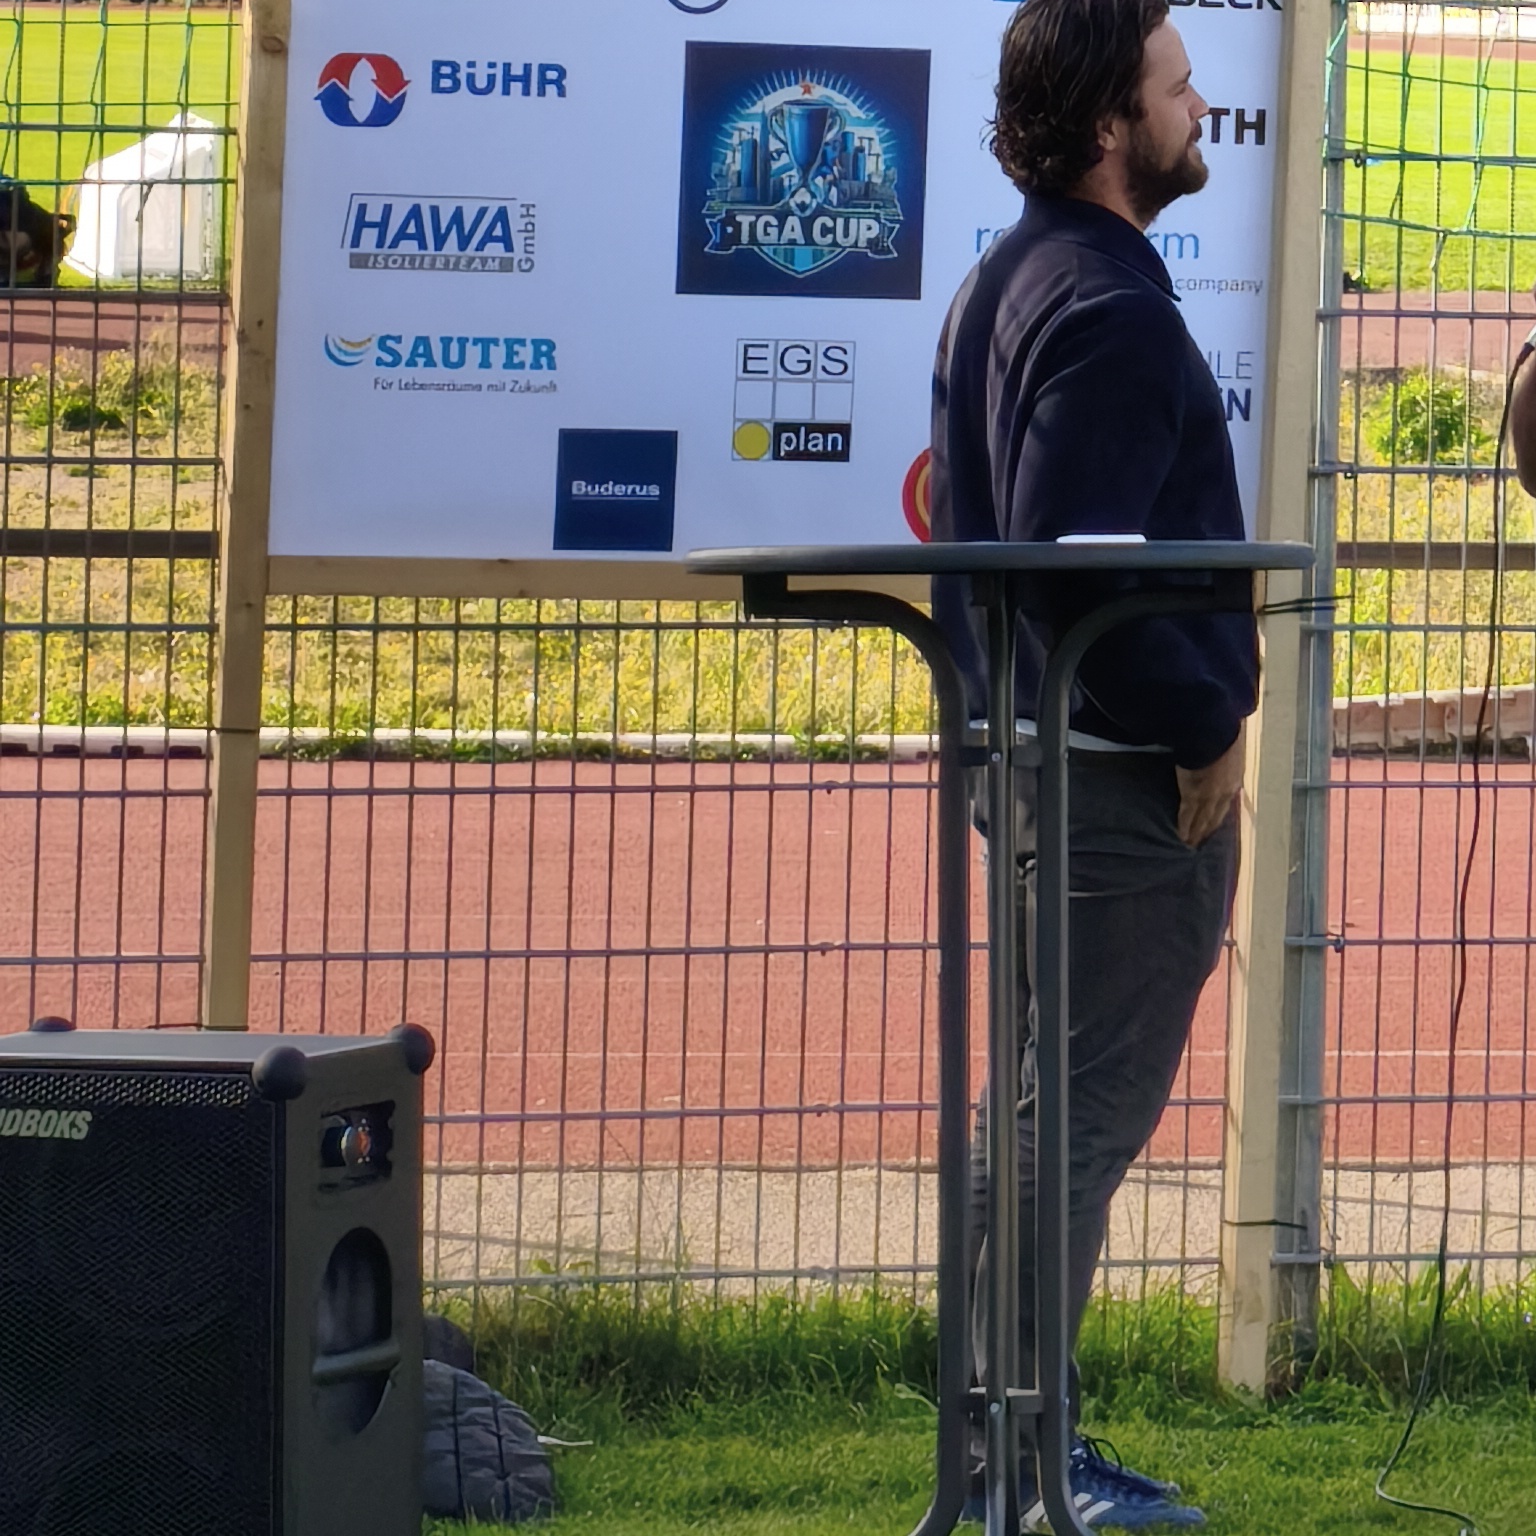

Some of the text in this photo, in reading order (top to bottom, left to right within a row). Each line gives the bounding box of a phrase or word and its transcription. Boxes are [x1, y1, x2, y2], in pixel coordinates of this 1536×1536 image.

[350, 203, 514, 253] HAWA
[517, 203, 536, 273] GmbH
[736, 215, 880, 247] TGA CUP
[368, 255, 500, 272] ISOLIERTEAM
[1175, 278, 1263, 296] company
[375, 334, 557, 370] SAUTER
[742, 344, 848, 376] EGS
[374, 377, 394, 390] Für
[780, 431, 843, 456] plan
[572, 480, 660, 496] Buderus
[0, 1108, 93, 1140] DBOKS
